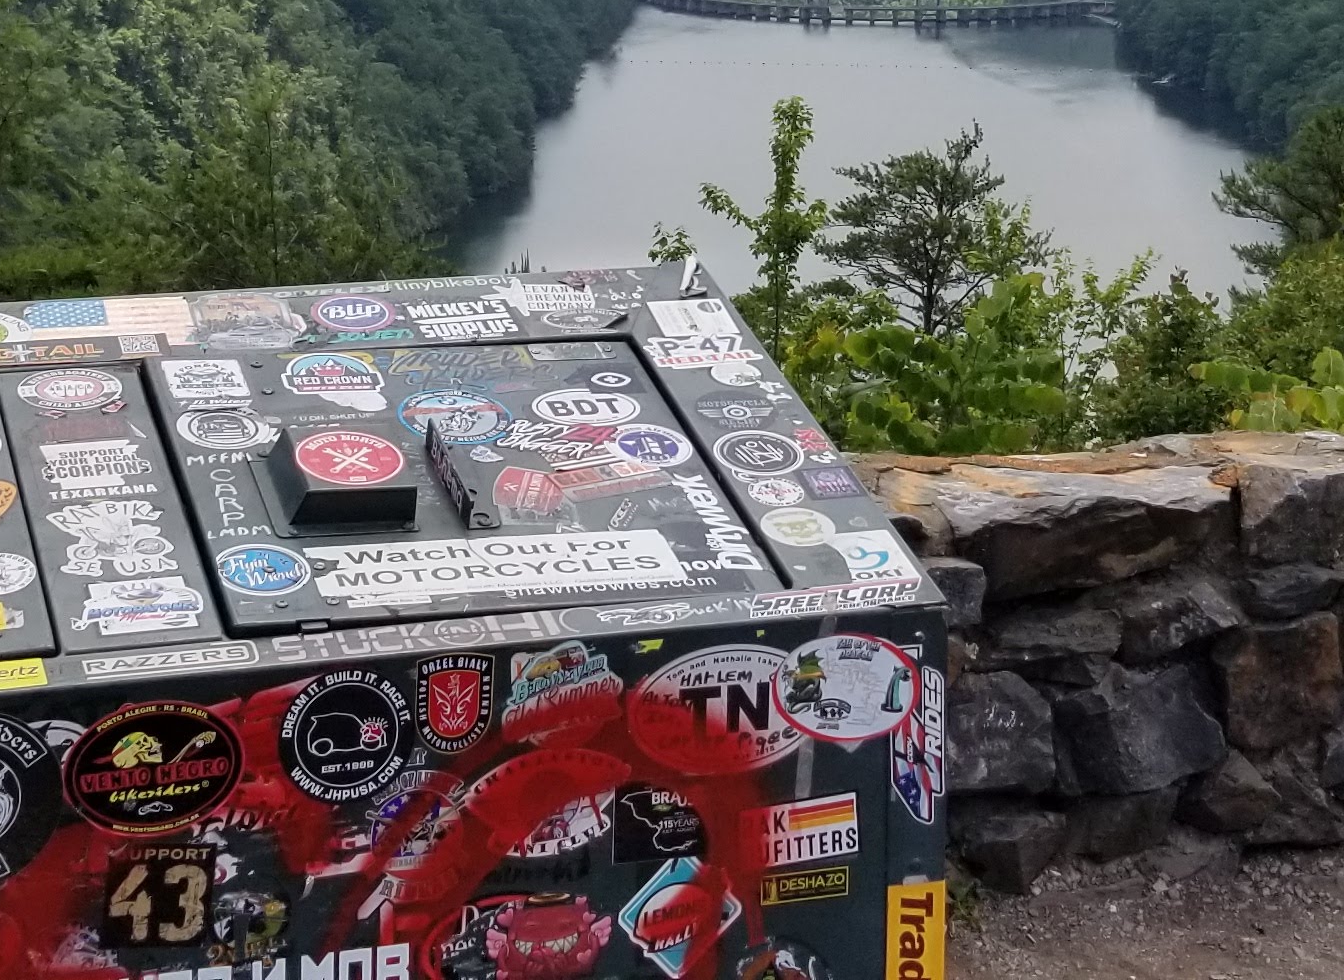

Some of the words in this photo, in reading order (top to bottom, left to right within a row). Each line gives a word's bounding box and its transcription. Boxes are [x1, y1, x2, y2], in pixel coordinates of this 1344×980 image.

[525, 293, 592, 303] BREWING
[528, 301, 593, 311] COMPANY
[407, 299, 506, 320] MICKEY'S
[419, 320, 519, 339] SURPLUS
[34, 344, 105, 357] TAIL
[657, 336, 738, 357] P-47
[293, 376, 320, 386] RED
[324, 375, 372, 386] CROWN
[546, 397, 621, 418] BDT
[340, 434, 387, 449] NORTH
[48, 456, 90, 467] YOUR
[94, 452, 140, 464] LOCAL
[58, 447, 125, 459] SUPPORT
[44, 460, 151, 480] SCORPIONS
[49, 484, 157, 500] TEXARKANA
[345, 546, 471, 565] Watch
[484, 542, 556, 558] Out
[567, 539, 632, 557] For
[73, 561, 98, 573] SE
[118, 557, 172, 573] USA
[335, 555, 662, 588] MOTORCYCLES
[851, 569, 903, 581] OKI
[272, 623, 436, 662] STUCK
[86, 647, 247, 674] RAZZERS
[667, 669, 684, 682] Tom
[689, 659, 707, 670] and
[282, 695, 308, 739] DREAM
[307, 682, 324, 697] IT.
[325, 670, 363, 686] BUILD
[365, 673, 378, 686] IT.
[379, 680, 407, 709] RACE
[400, 712, 412, 726] IT.
[679, 680, 770, 735] TN
[421, 721, 486, 753] MOTORCYCLISTS
[81, 766, 151, 794] VENTO
[158, 758, 229, 784] NEGRO
[290, 755, 404, 801] WWW.JHPUSA.COM
[779, 873, 845, 892] DESHAZO
[108, 863, 208, 944] 43
